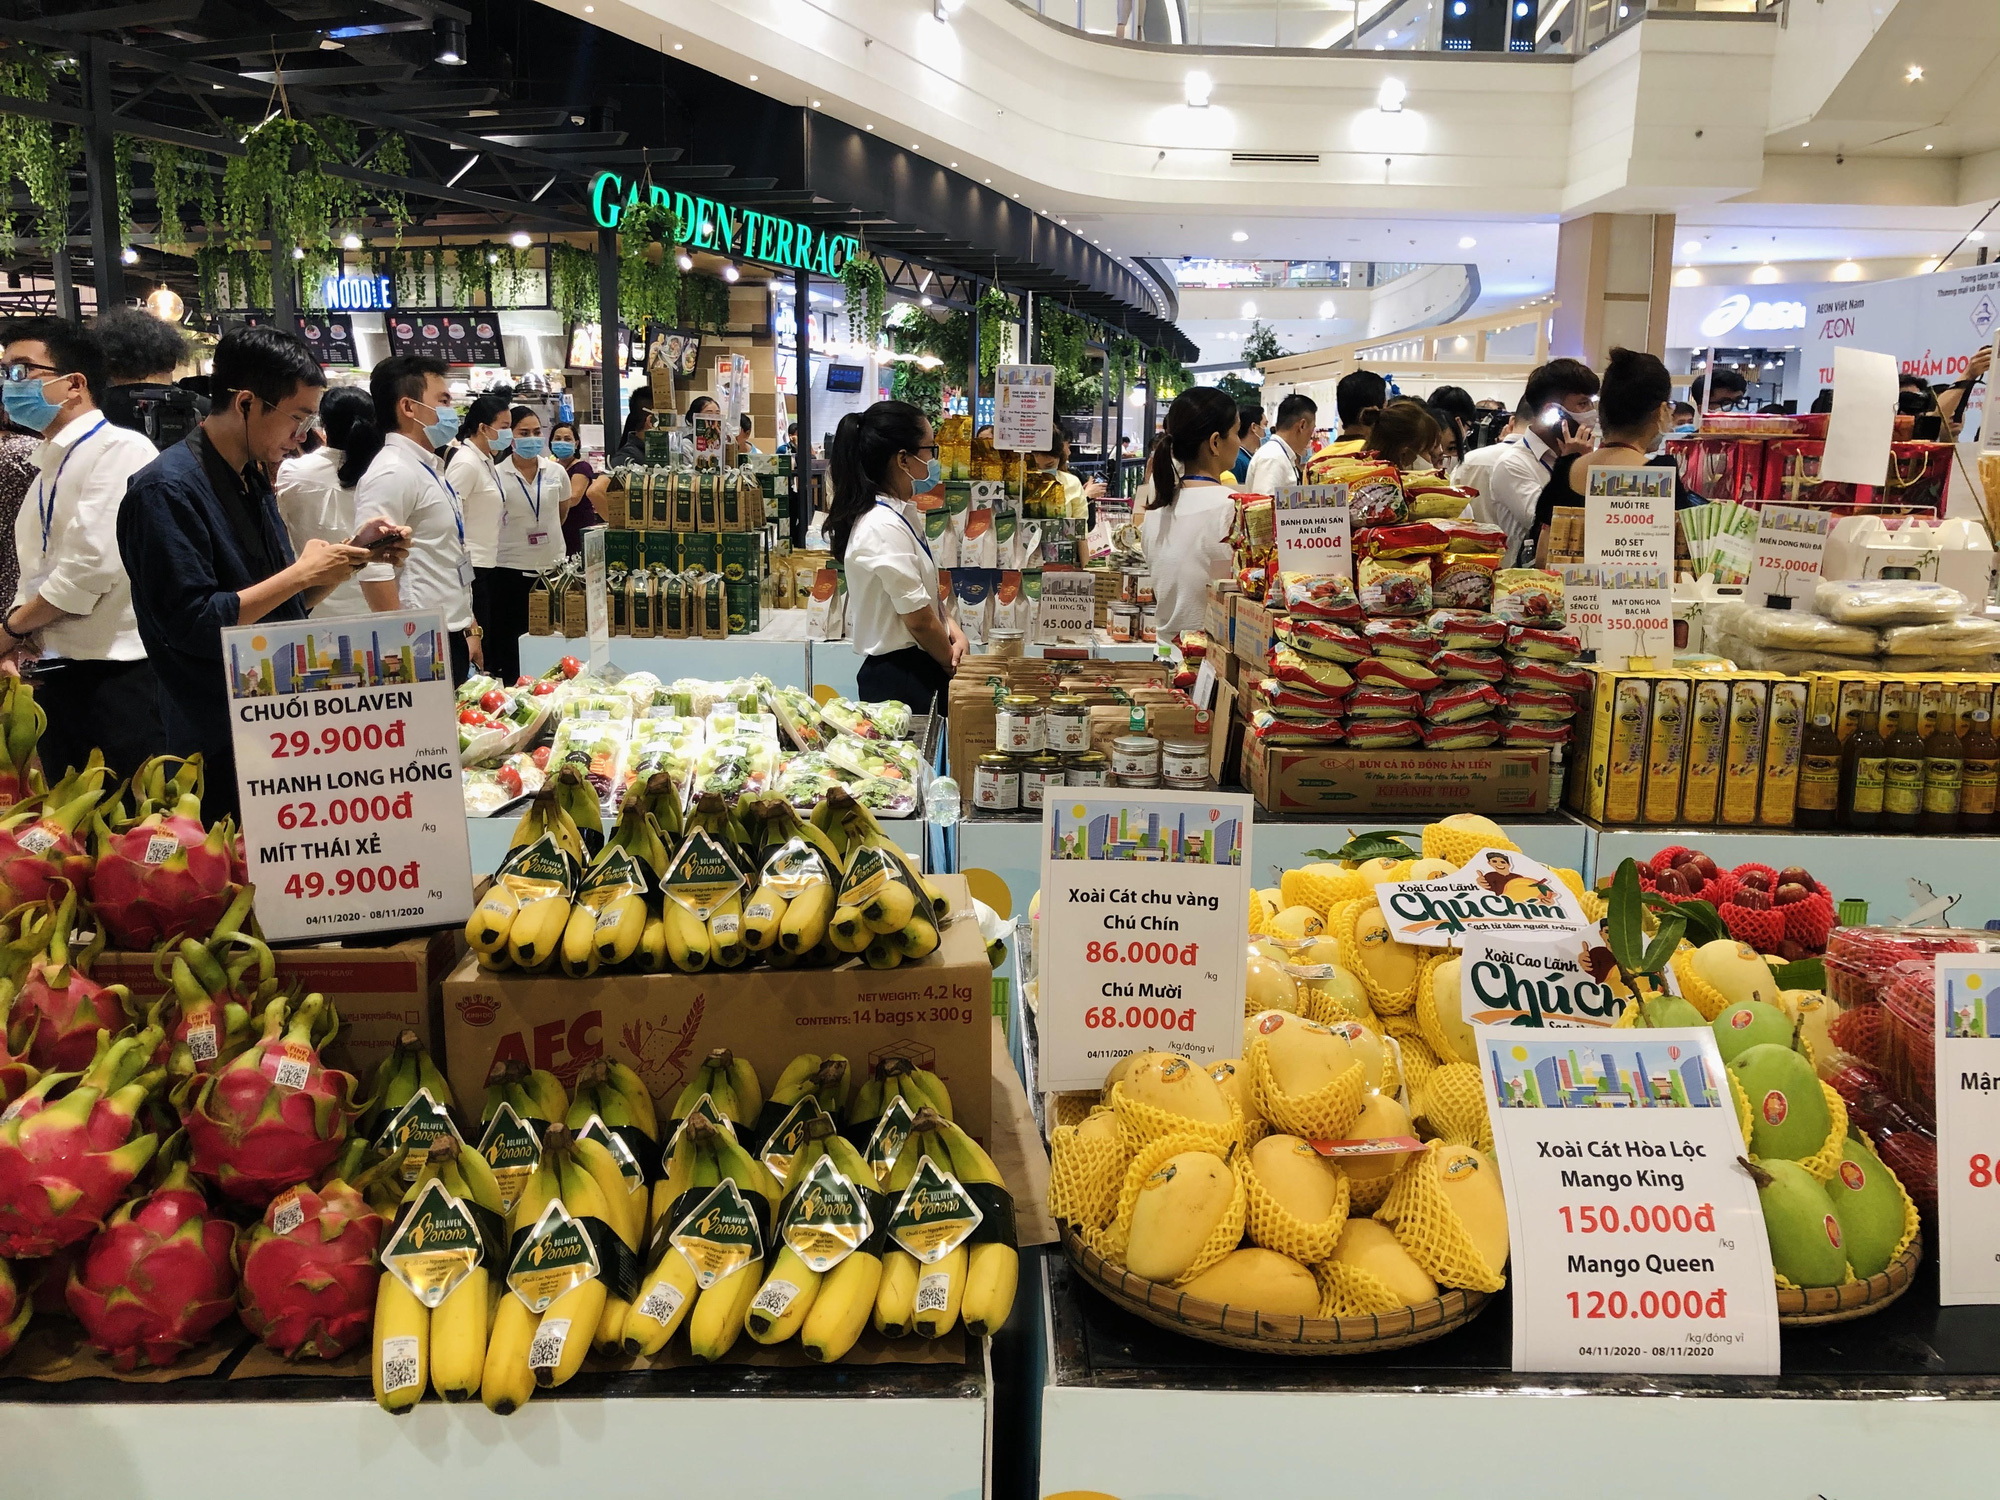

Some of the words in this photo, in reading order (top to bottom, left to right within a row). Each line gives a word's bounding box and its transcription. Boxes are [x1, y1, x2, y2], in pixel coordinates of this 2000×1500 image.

[1817, 304, 1834, 314] AEON
[1606, 514, 1654, 525] 25.000đ
[1286, 536, 1342, 550] 14.000đ
[1778, 539, 1798, 547] DONG
[1758, 556, 1818, 573] 125.000đ
[1043, 619, 1082, 630] 45.000
[1607, 618, 1668, 630] 350.000đ
[240, 695, 309, 723] CHUỐI
[315, 691, 413, 716] BOLAVEN
[270, 719, 406, 759] 29.900đ
[415, 747, 448, 758] /nhánh
[247, 774, 322, 797] THANH
[328, 768, 385, 790] LONG
[390, 760, 452, 783] HỒNG
[277, 791, 414, 830] 62.000đ
[421, 823, 437, 833] /kg
[260, 841, 297, 864] MÍT
[301, 837, 350, 860] THÁI
[356, 833, 382, 854] XẺ
[284, 861, 420, 899] 49.900đ
[1397, 883, 1425, 893] Xoài
[1426, 884, 1448, 893] Cao
[1449, 882, 1480, 892] Lãnh
[427, 889, 443, 900] /kg
[1068, 888, 1105, 903] Xoài
[1109, 889, 1138, 904] Cát
[1141, 889, 1172, 905] chu
[1176, 891, 1219, 910] vàng
[305, 912, 360, 925] 04/11/2020
[370, 907, 424, 920] 08/11/2020
[1390, 891, 1484, 932] Chú
[1481, 894, 1566, 920] Chín
[1103, 915, 1136, 930] Chú
[1140, 915, 1179, 931] Chín
[1086, 941, 1199, 966] 86.000đ
[1485, 947, 1514, 965] Xoài
[1516, 954, 1542, 968] Cao
[1544, 956, 1580, 973] Lãnh
[1204, 972, 1218, 982] /kg
[858, 993, 878, 1002] NET
[879, 992, 920, 1002] WEIGHT:
[923, 985, 948, 1000] 4.2
[952, 984, 972, 1002] kg
[1101, 982, 1134, 998] Chú
[1138, 982, 1182, 999] Mười
[795, 1016, 851, 1026] CONTENTS:
[853, 1010, 871, 1024] 14
[875, 1008, 913, 1026] bags
[917, 1012, 926, 1022] x
[930, 1007, 959, 1022] 300
[962, 1008, 972, 1024] g
[1085, 1006, 1197, 1032] 68.000đ
[483, 1010, 604, 1090] AFC
[1536, 1141, 1583, 1158] Xoài
[1587, 1141, 1622, 1158] Cát
[1627, 1141, 1666, 1158] Hòa
[1669, 1140, 1706, 1162] Lộc
[1561, 1170, 1632, 1192] Mango
[1637, 1170, 1684, 1191] King
[435, 1218, 462, 1229] BOLAVEN
[1558, 1203, 1716, 1233] 150.000đ
[554, 1236, 578, 1247] BOLAVEN
[1719, 1238, 1735, 1250] /kg
[1567, 1255, 1640, 1277] Mango
[1646, 1254, 1715, 1275] Queen
[1566, 1288, 1727, 1319] 120.000đ
[1579, 1346, 1641, 1357] 04/11/2020
[1652, 1346, 1714, 1357] 08/11/2020
